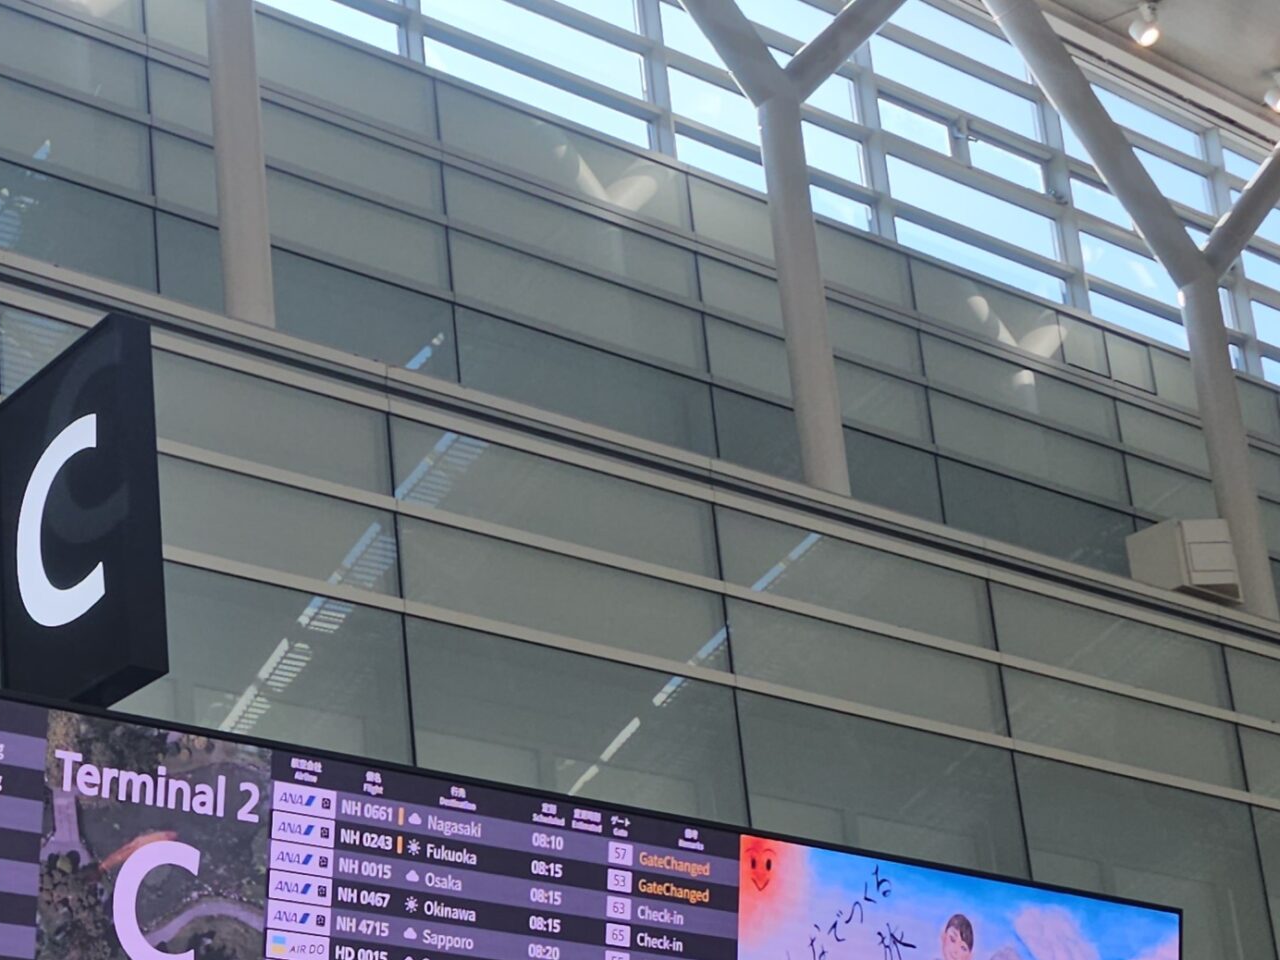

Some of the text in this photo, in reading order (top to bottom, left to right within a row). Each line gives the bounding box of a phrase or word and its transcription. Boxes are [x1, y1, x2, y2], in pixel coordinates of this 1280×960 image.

[16, 414, 104, 626] C
[55, 750, 260, 822] Terminal 2
[279, 791, 709, 876] ANA NH 0661 Nagasaki 08:10 57 GateChanged
[275, 879, 682, 951] ANA NH 0467 Okinawa 08:15 65 Check-in
